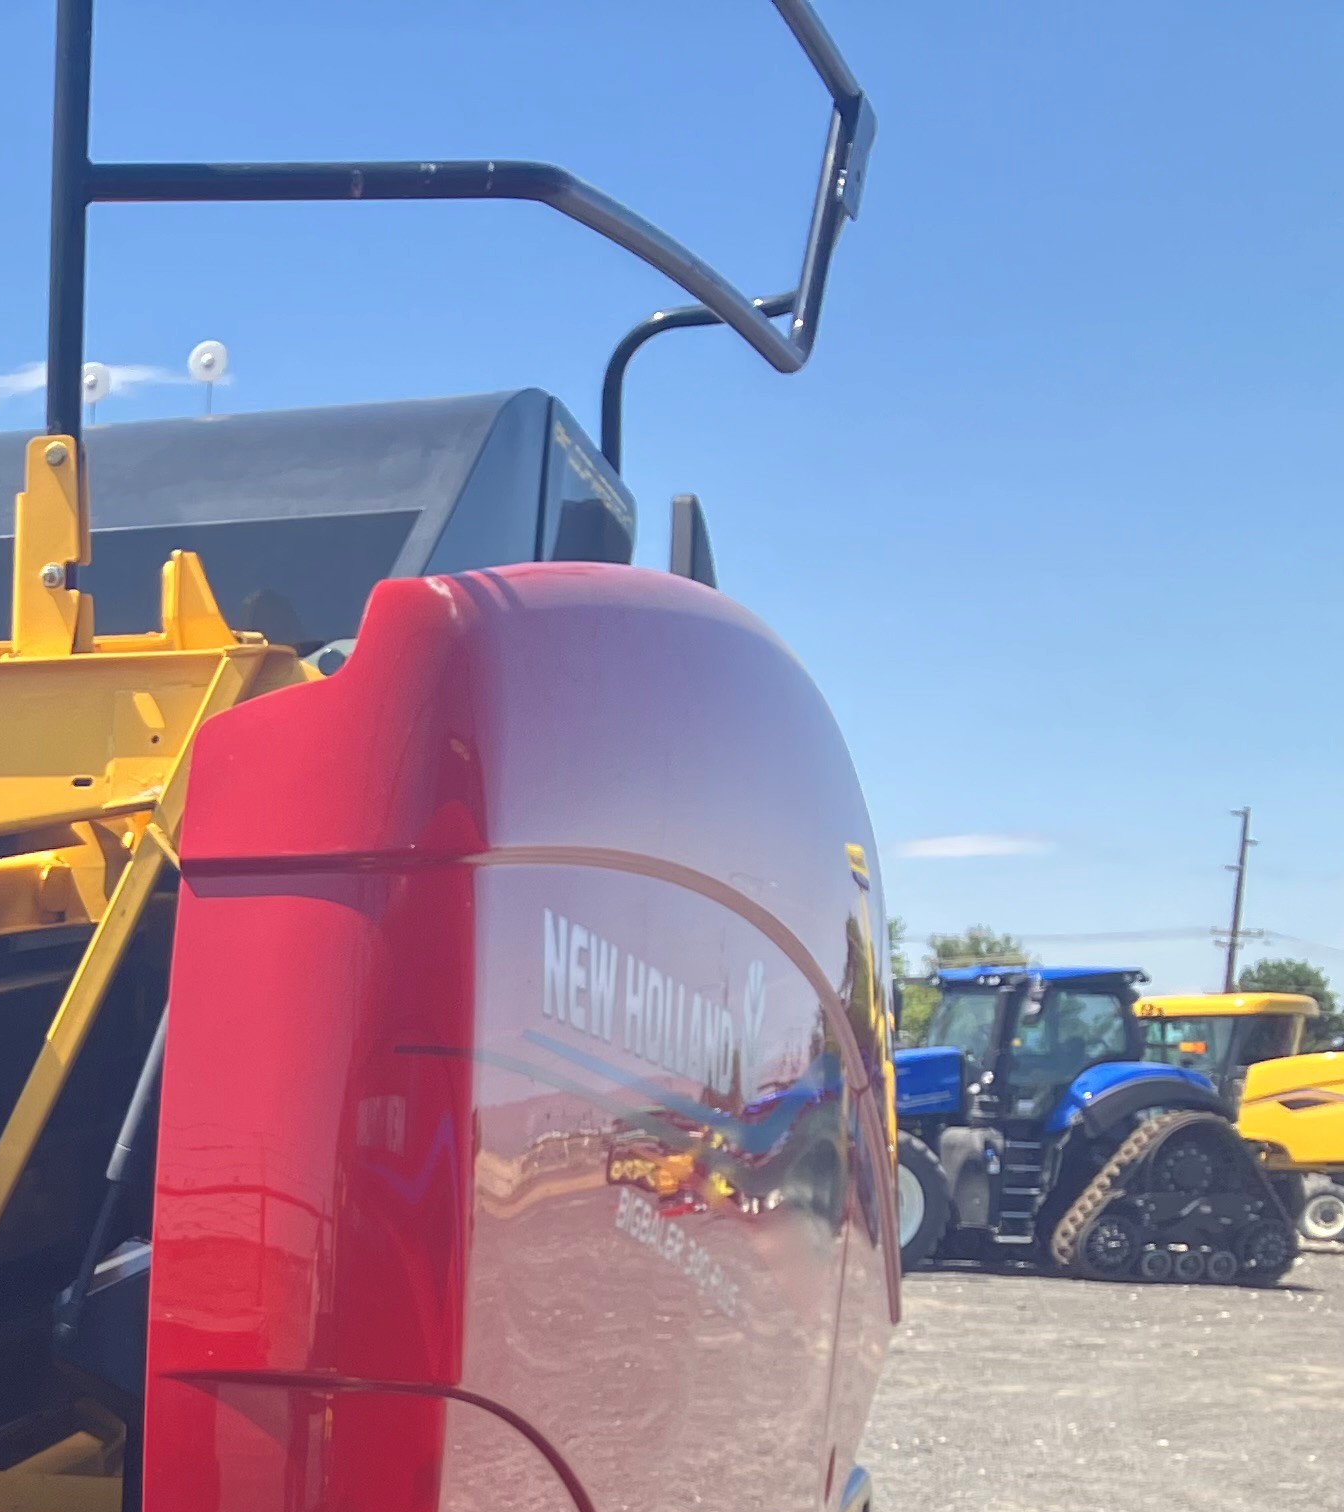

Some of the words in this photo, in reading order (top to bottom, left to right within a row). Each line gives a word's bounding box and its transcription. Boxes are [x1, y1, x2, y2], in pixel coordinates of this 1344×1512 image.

[543, 907, 618, 1045] NEW
[624, 953, 734, 1097] HOLLAND
[615, 1186, 685, 1265] BIGBALER
